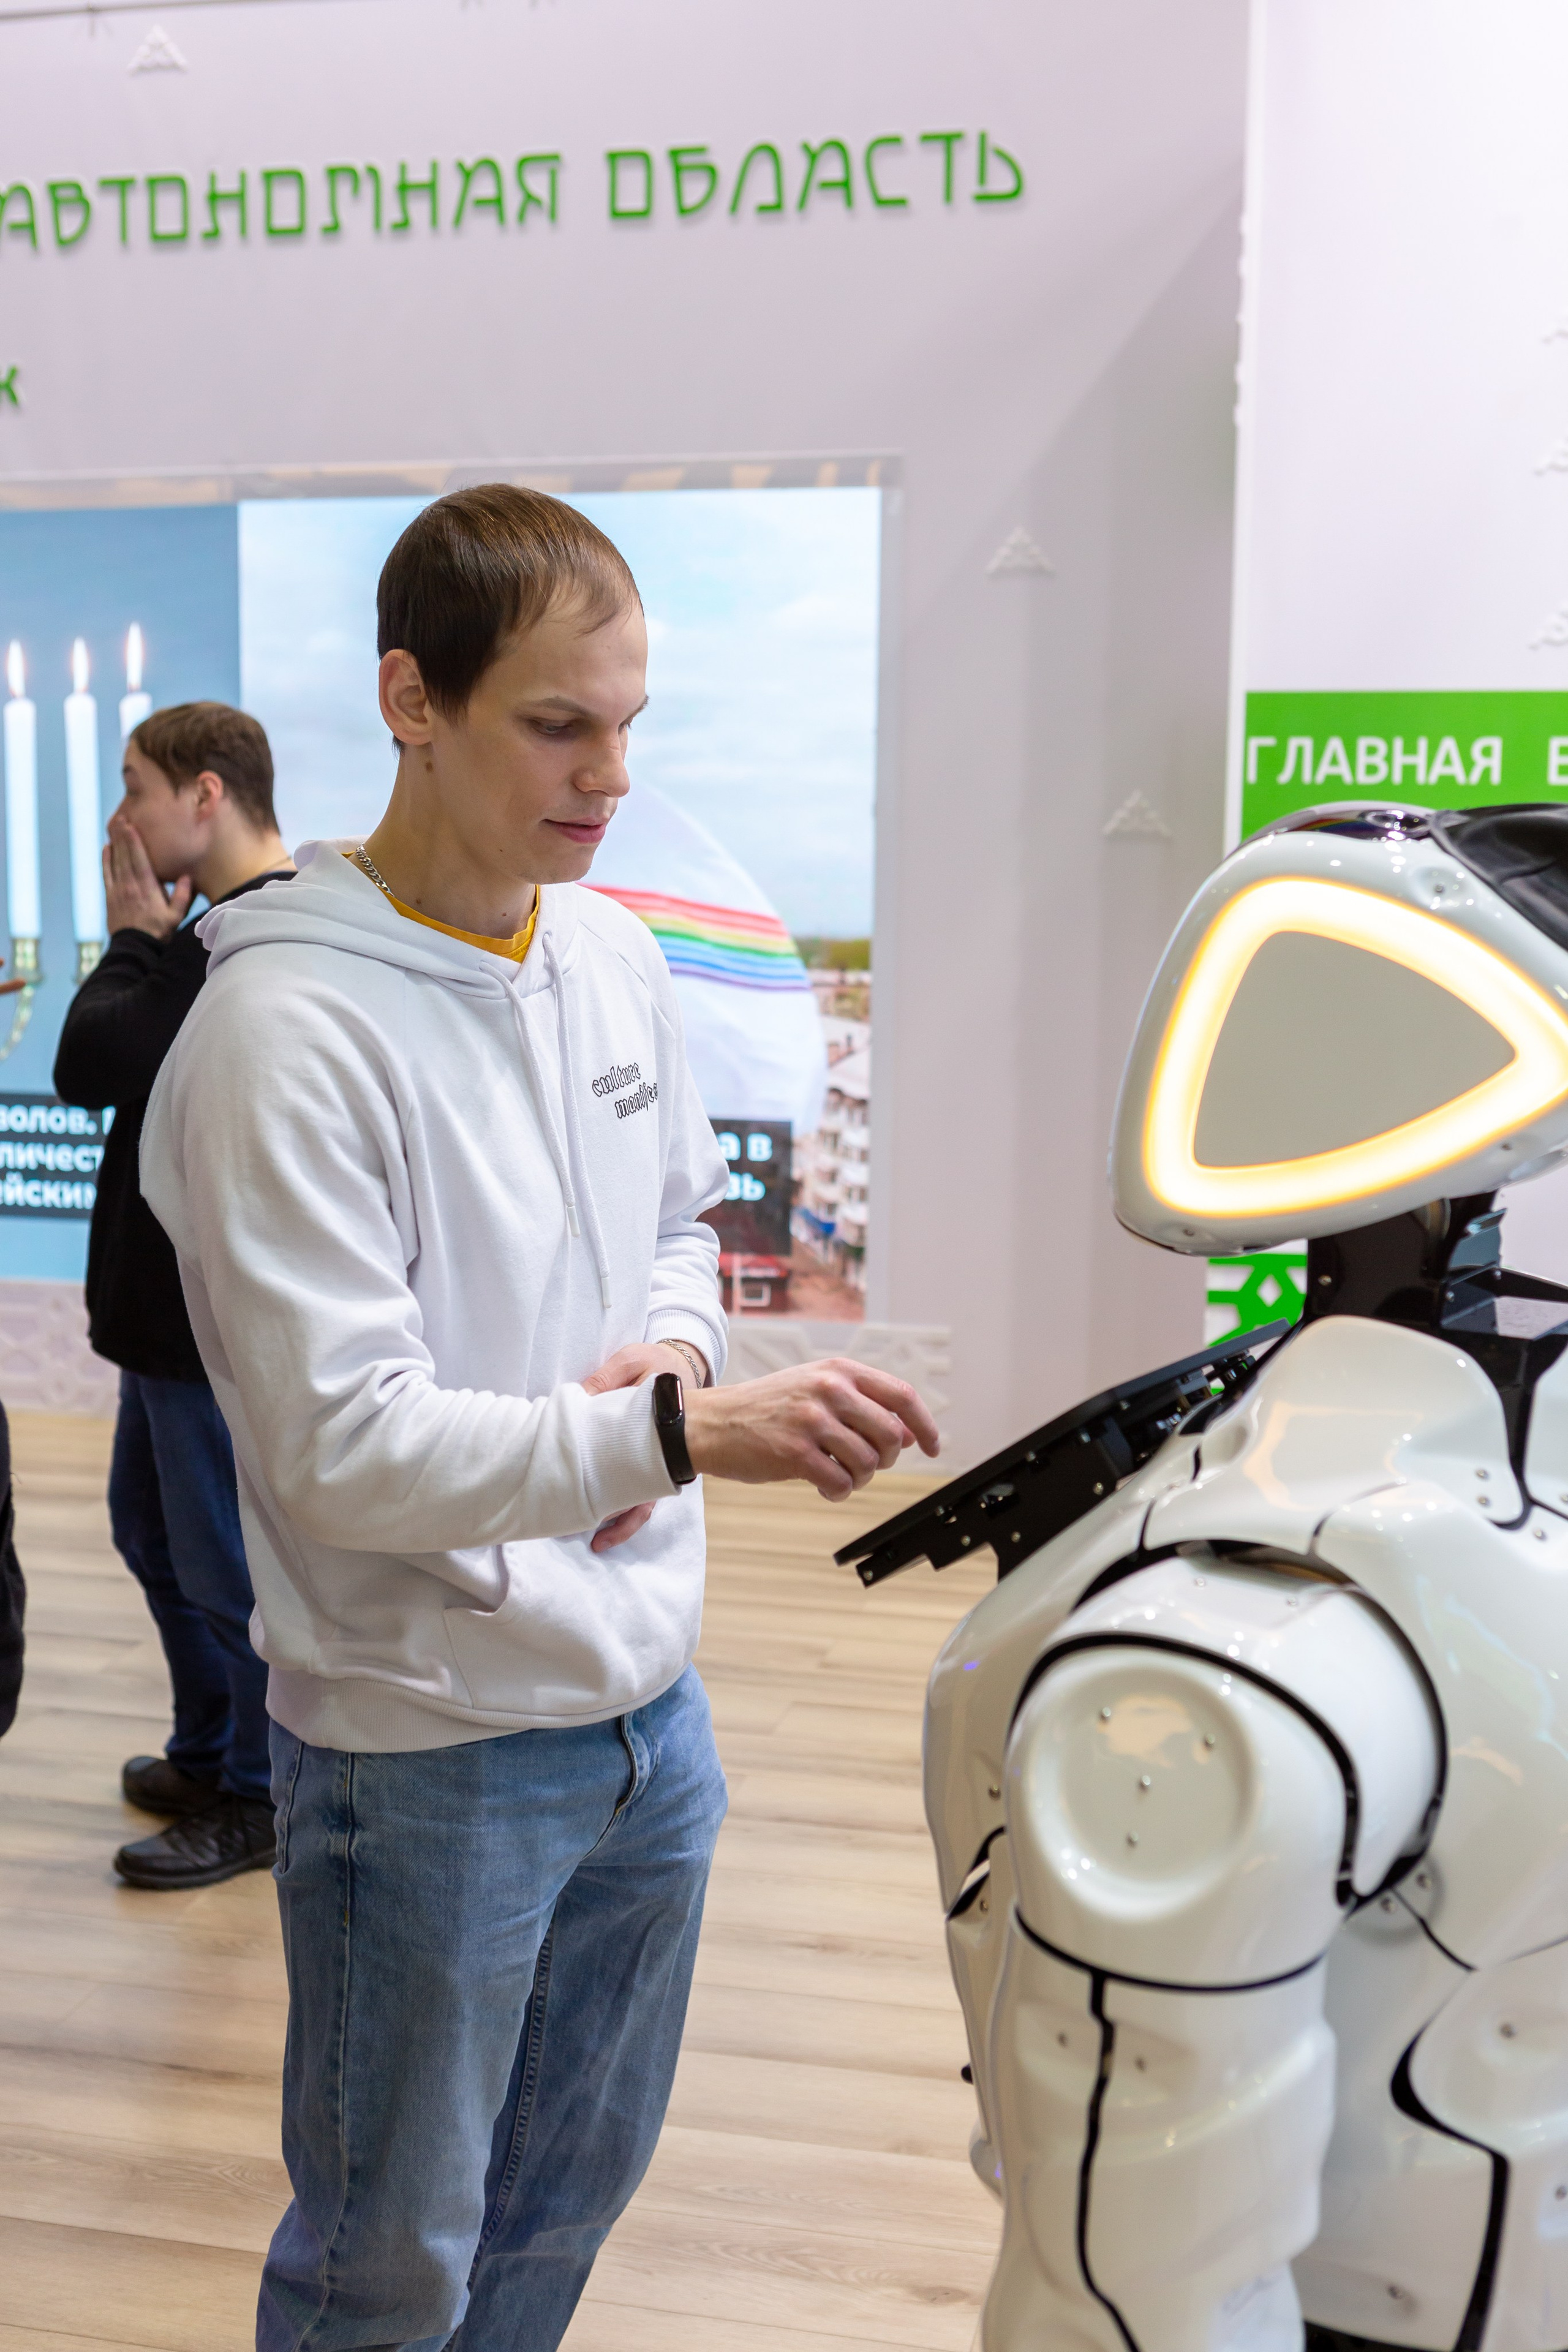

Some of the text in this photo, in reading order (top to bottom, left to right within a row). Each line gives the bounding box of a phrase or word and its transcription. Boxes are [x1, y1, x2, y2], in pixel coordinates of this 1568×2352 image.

[0, 131, 1023, 247] АВТОНОМНАЯ ОБЛАСТЬ
[1246, 736, 1503, 785] ГЛАВНАЯ
[592, 1062, 641, 1097] culture
